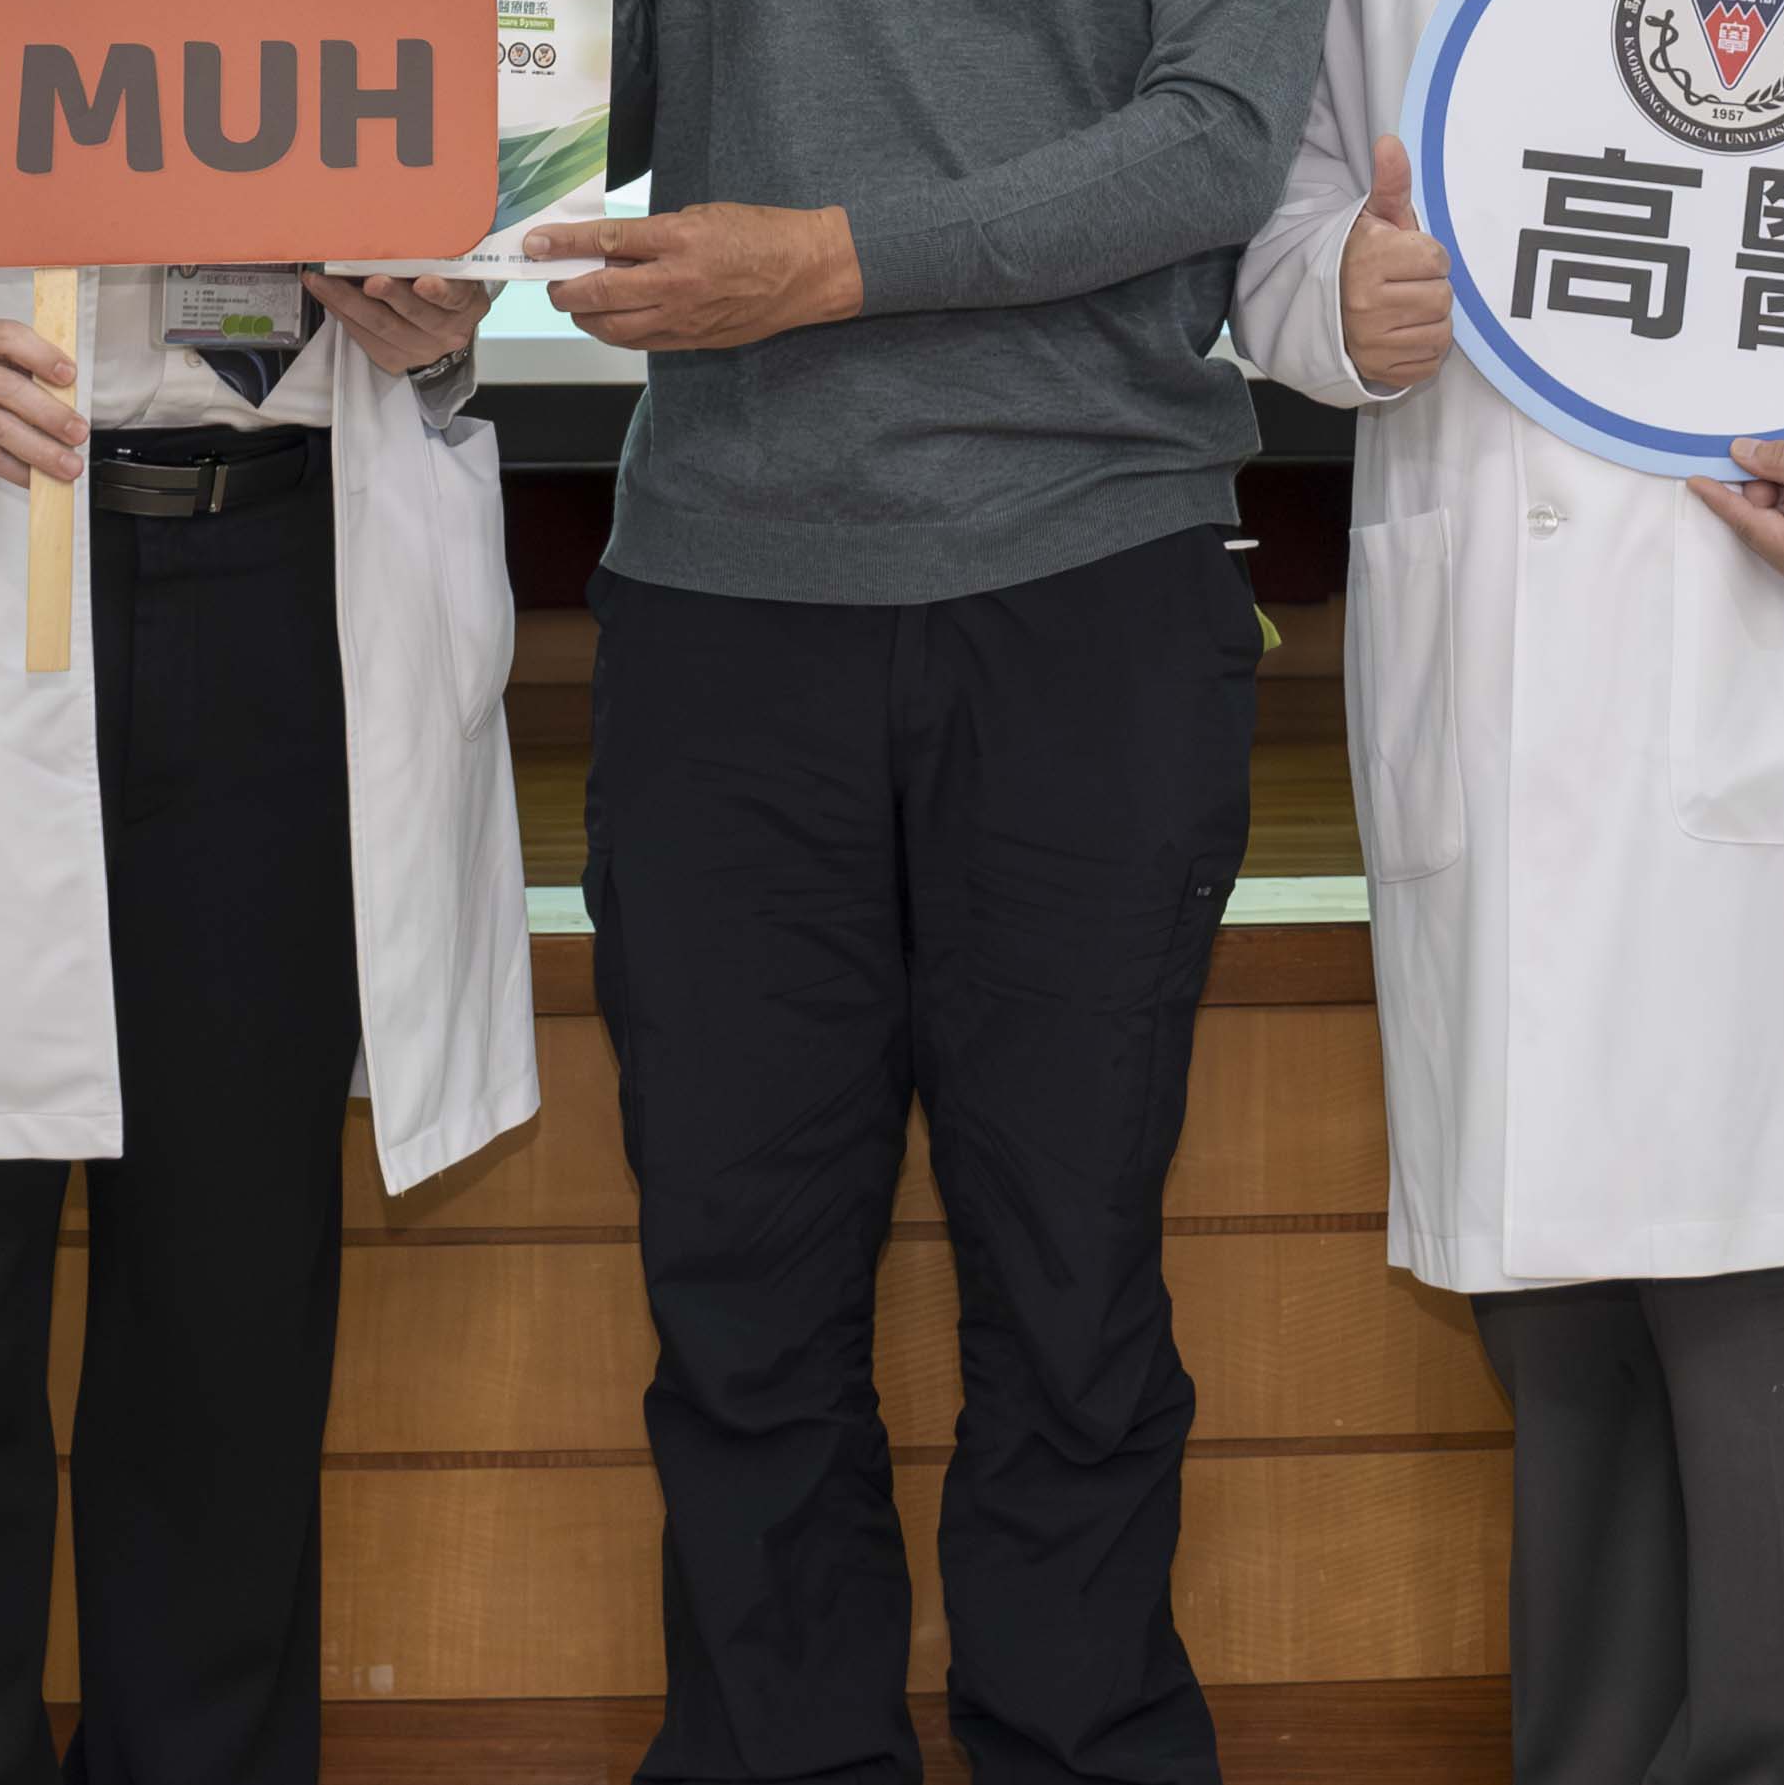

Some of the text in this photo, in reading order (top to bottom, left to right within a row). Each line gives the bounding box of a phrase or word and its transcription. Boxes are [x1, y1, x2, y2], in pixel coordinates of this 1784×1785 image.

[1623, 36, 1666, 114] KAOHSIUNG
[1661, 109, 1723, 144] MEDICAL
[1711, 108, 1745, 122] 1957
